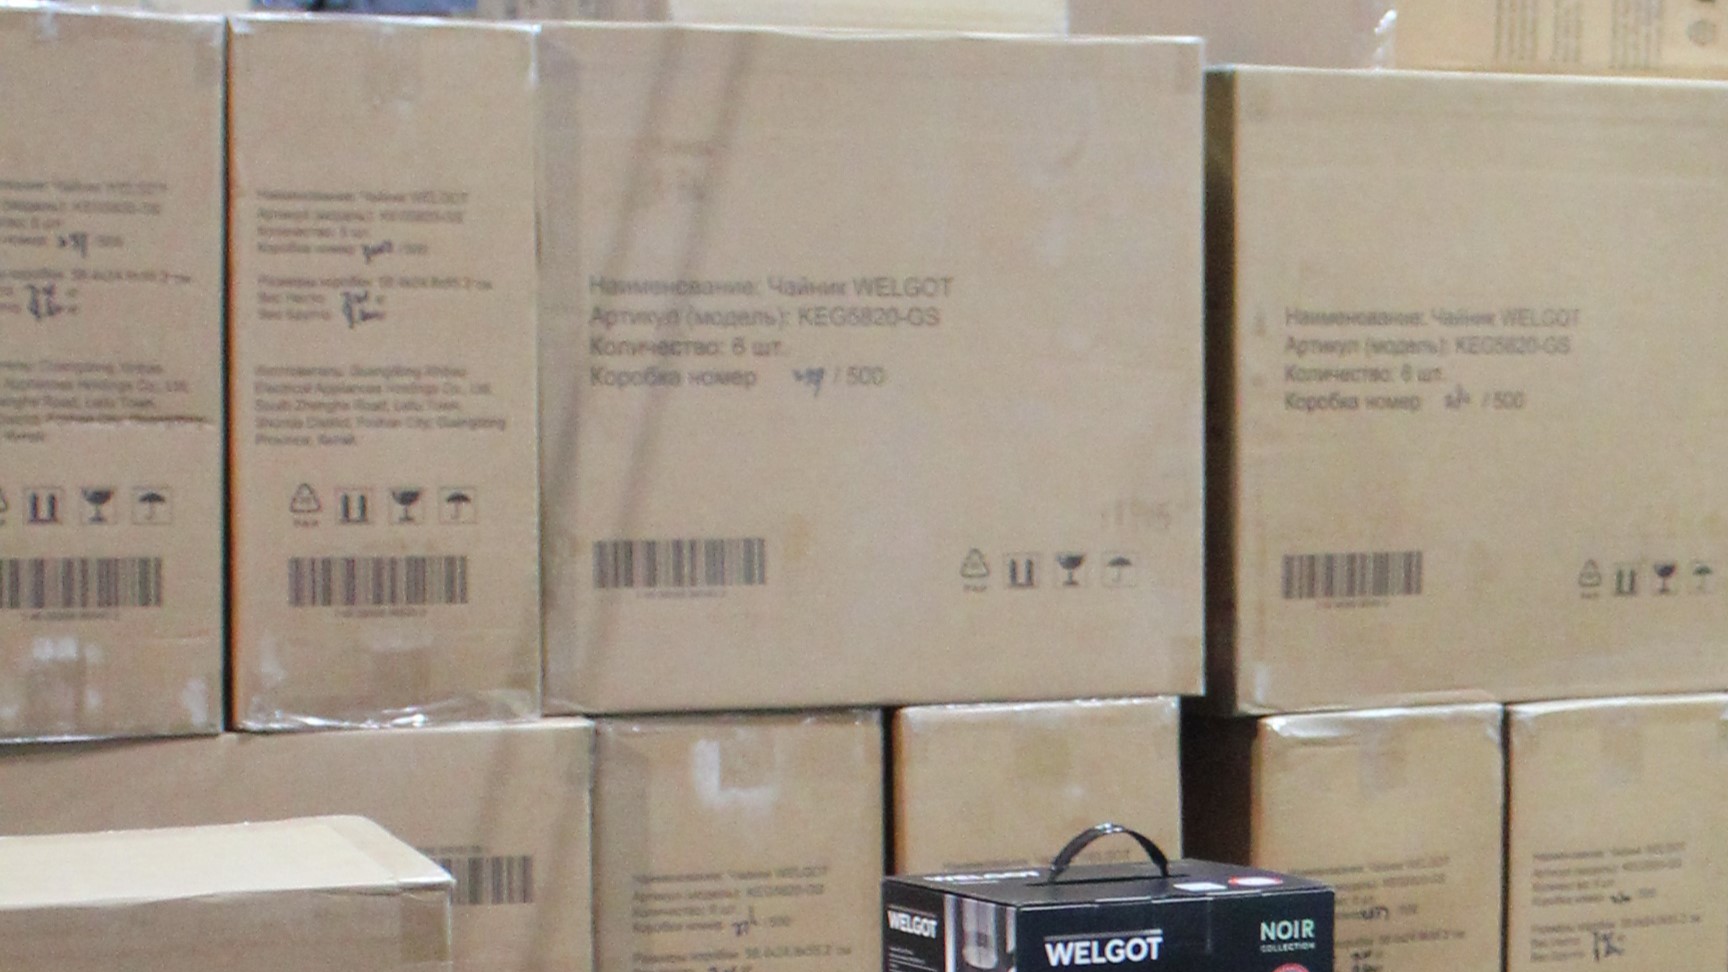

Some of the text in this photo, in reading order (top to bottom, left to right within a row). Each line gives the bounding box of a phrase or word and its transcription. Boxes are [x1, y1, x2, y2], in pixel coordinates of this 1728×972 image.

[852, 276, 954, 297] WELGOT
[888, 909, 938, 939] WELGOT
[1260, 918, 1316, 941] NOIR
[1044, 936, 1164, 967] WELGOT
[1260, 942, 1315, 953] COLLECTION
